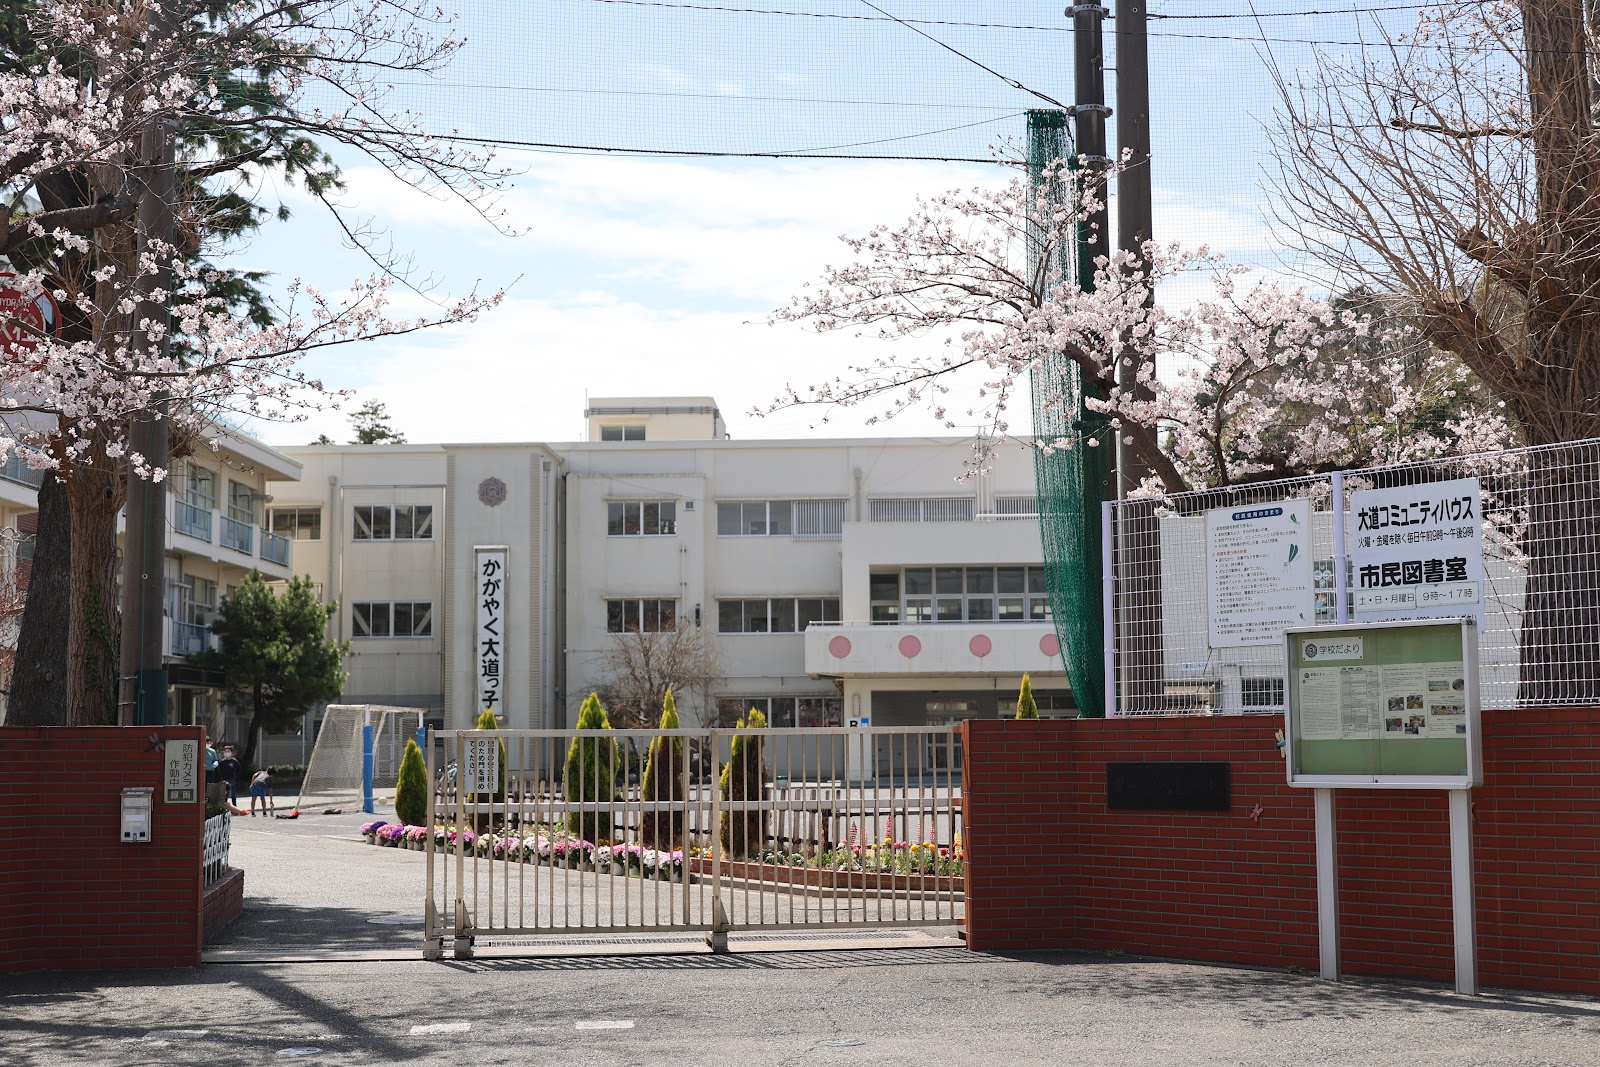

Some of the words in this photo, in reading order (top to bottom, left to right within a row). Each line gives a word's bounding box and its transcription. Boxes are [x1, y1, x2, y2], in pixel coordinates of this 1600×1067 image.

[1358, 497, 1474, 531] 大道コミュニティハウス
[1359, 556, 1468, 589] 市民図書室
[481, 558, 502, 709] かがやく大道っ子
[1319, 643, 1360, 655] 学校だより
[169, 759, 180, 788] 作動中
[182, 743, 193, 787] 防犯カメラ
